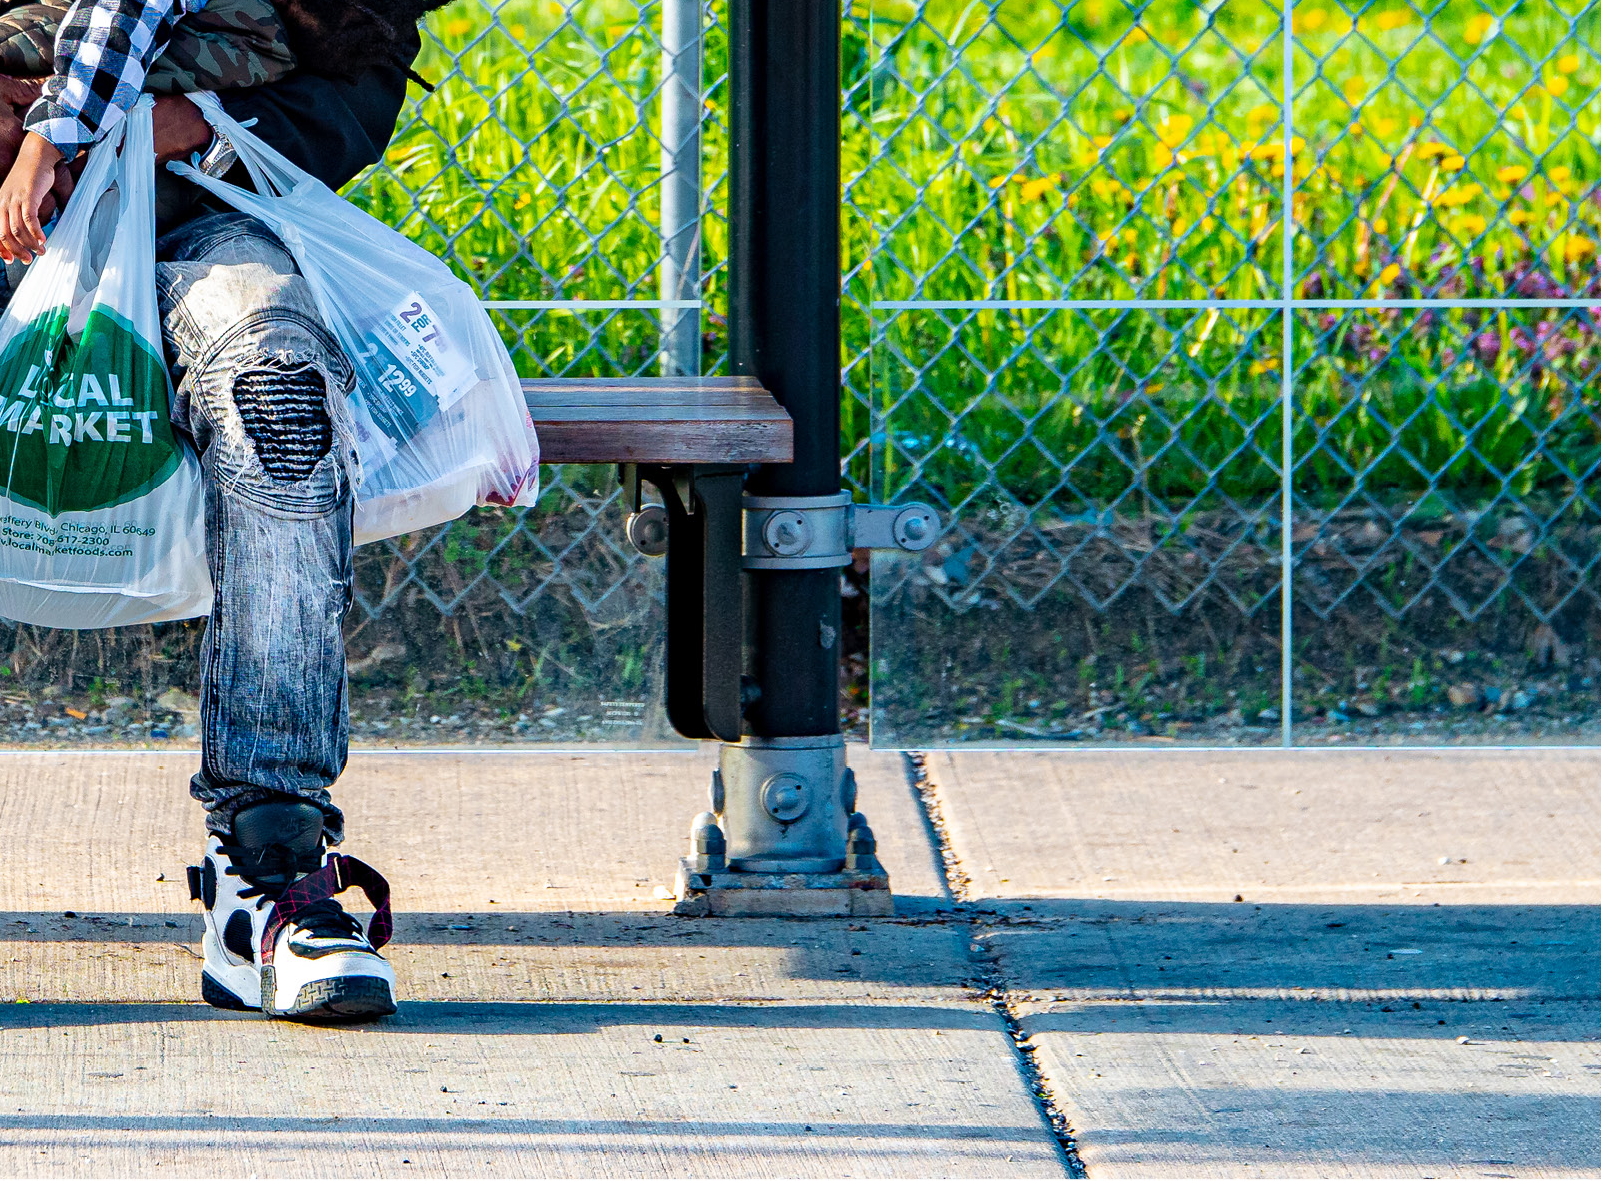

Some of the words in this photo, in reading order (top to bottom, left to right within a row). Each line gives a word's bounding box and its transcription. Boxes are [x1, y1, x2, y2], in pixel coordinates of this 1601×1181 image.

[411, 313, 432, 333] FOR
[18, 364, 134, 408] LOCAL
[1, 527, 34, 540] Store:
[60, 522, 108, 535] Chicago,
[110, 525, 120, 534] IL
[122, 526, 156, 537] 60649
